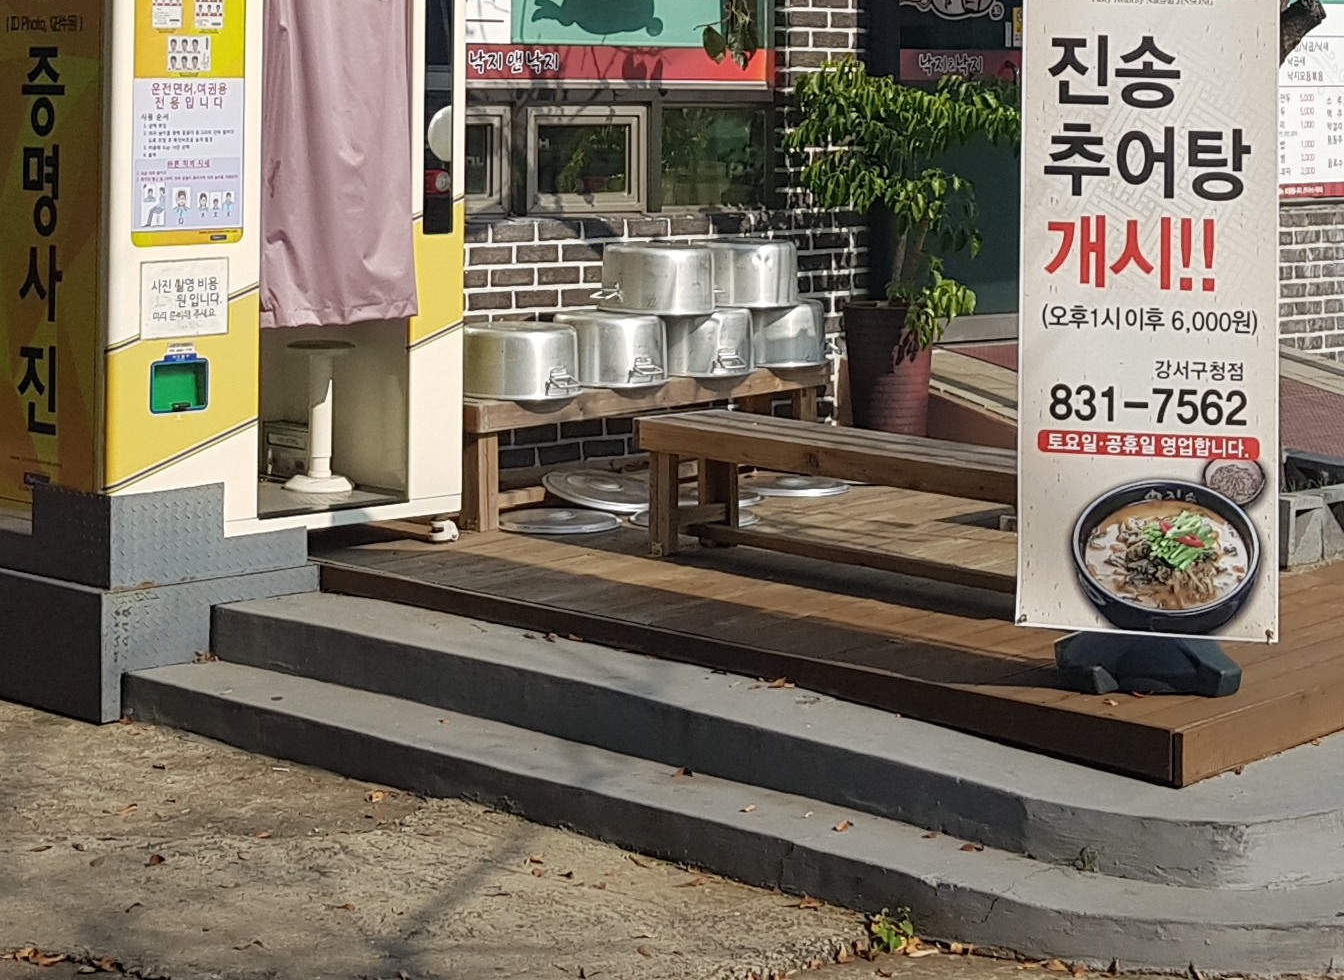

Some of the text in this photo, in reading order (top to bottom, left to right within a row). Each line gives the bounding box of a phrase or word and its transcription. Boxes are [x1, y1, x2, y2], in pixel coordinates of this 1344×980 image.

[469, 49, 559, 74] 낙지 앤 낙지
[1048, 35, 1181, 109] 진송
[1044, 123, 1251, 201] 추어탕
[17, 46, 66, 436] 증명사진
[1044, 215, 1215, 292] 개시!!
[197, 277, 218, 291] 비용
[1172, 310, 1258, 335] 6,000원)
[1155, 360, 1244, 382] 강서구청점
[1049, 383, 1248, 426] 831-7562
[1160, 436, 1250, 458] 영업합니다.
